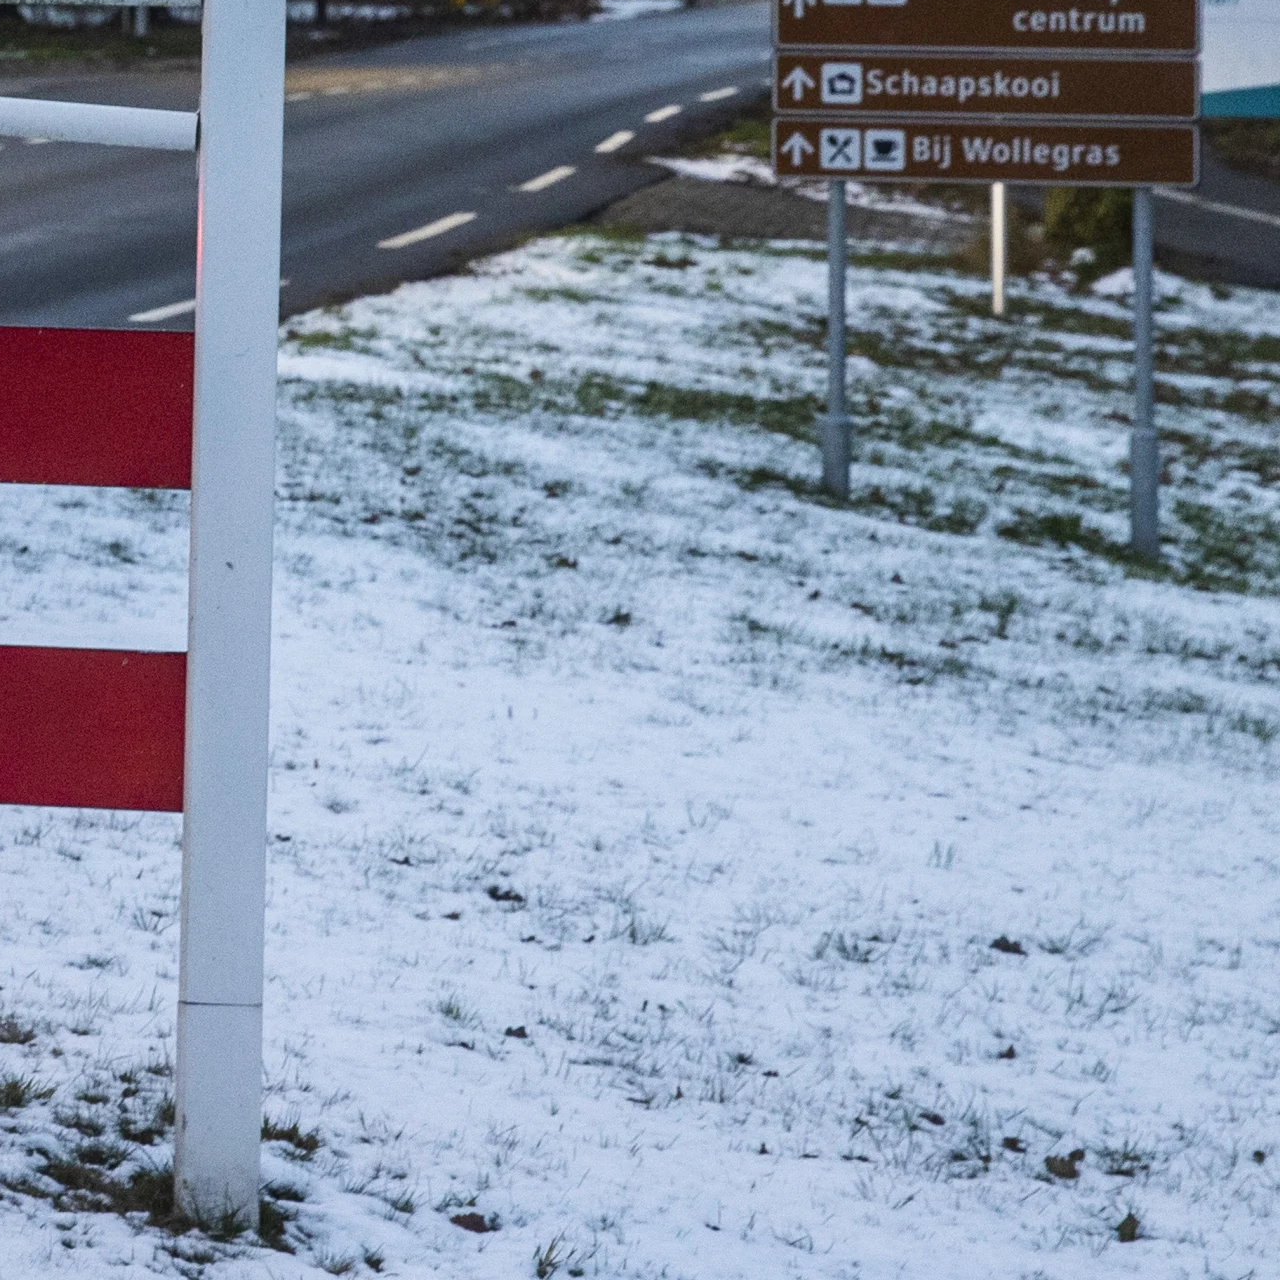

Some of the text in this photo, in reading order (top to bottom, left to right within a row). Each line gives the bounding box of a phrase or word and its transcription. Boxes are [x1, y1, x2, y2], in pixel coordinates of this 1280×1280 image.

[1013, 9, 1146, 32] centrum
[867, 70, 1060, 102] Schaapskooi
[913, 136, 1120, 171] Bij Wollegras
